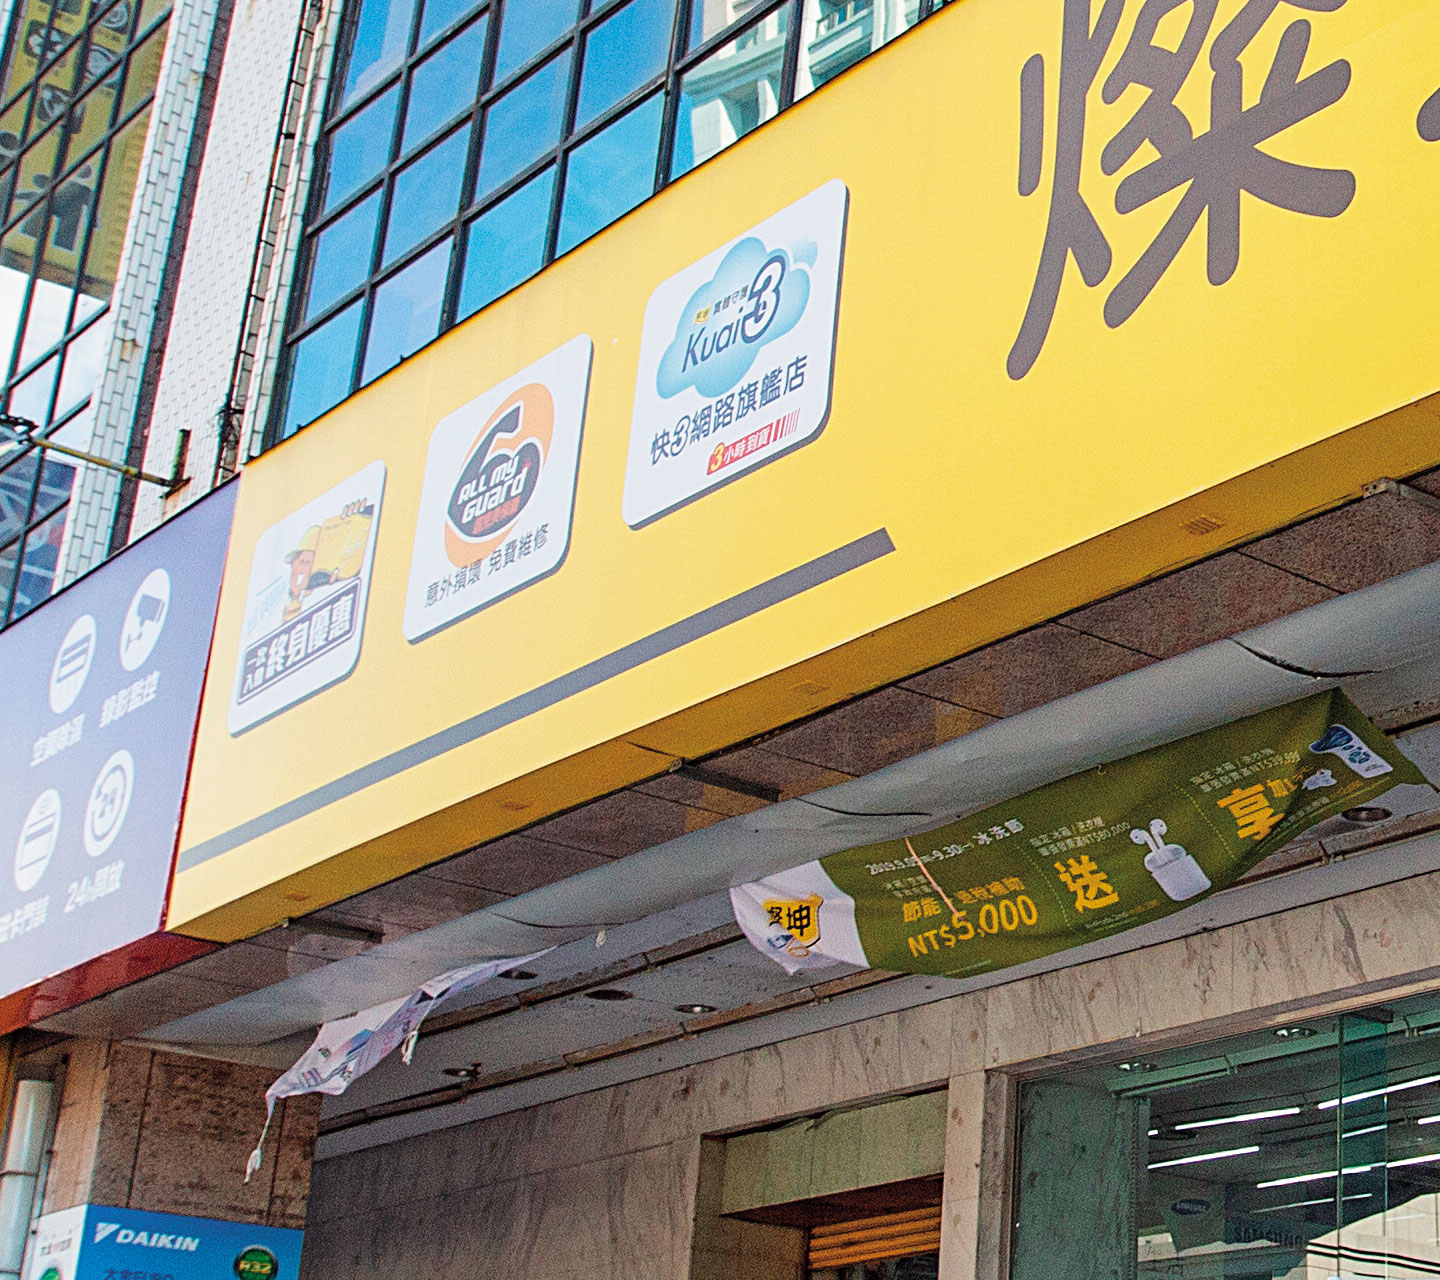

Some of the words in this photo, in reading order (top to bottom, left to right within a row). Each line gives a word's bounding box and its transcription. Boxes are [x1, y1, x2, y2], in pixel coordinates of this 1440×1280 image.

[651, 355, 808, 465] 快3網路旗艦店
[424, 559, 482, 609] 意外損壞
[488, 523, 549, 576] 免費維修
[264, 592, 354, 678] 終身優惠
[1216, 783, 1285, 841] 享
[902, 895, 943, 923] 節能
[1053, 855, 1120, 914] 送
[908, 894, 1038, 958] NT$5,000
[116, 1228, 201, 1252] DAIKIN
